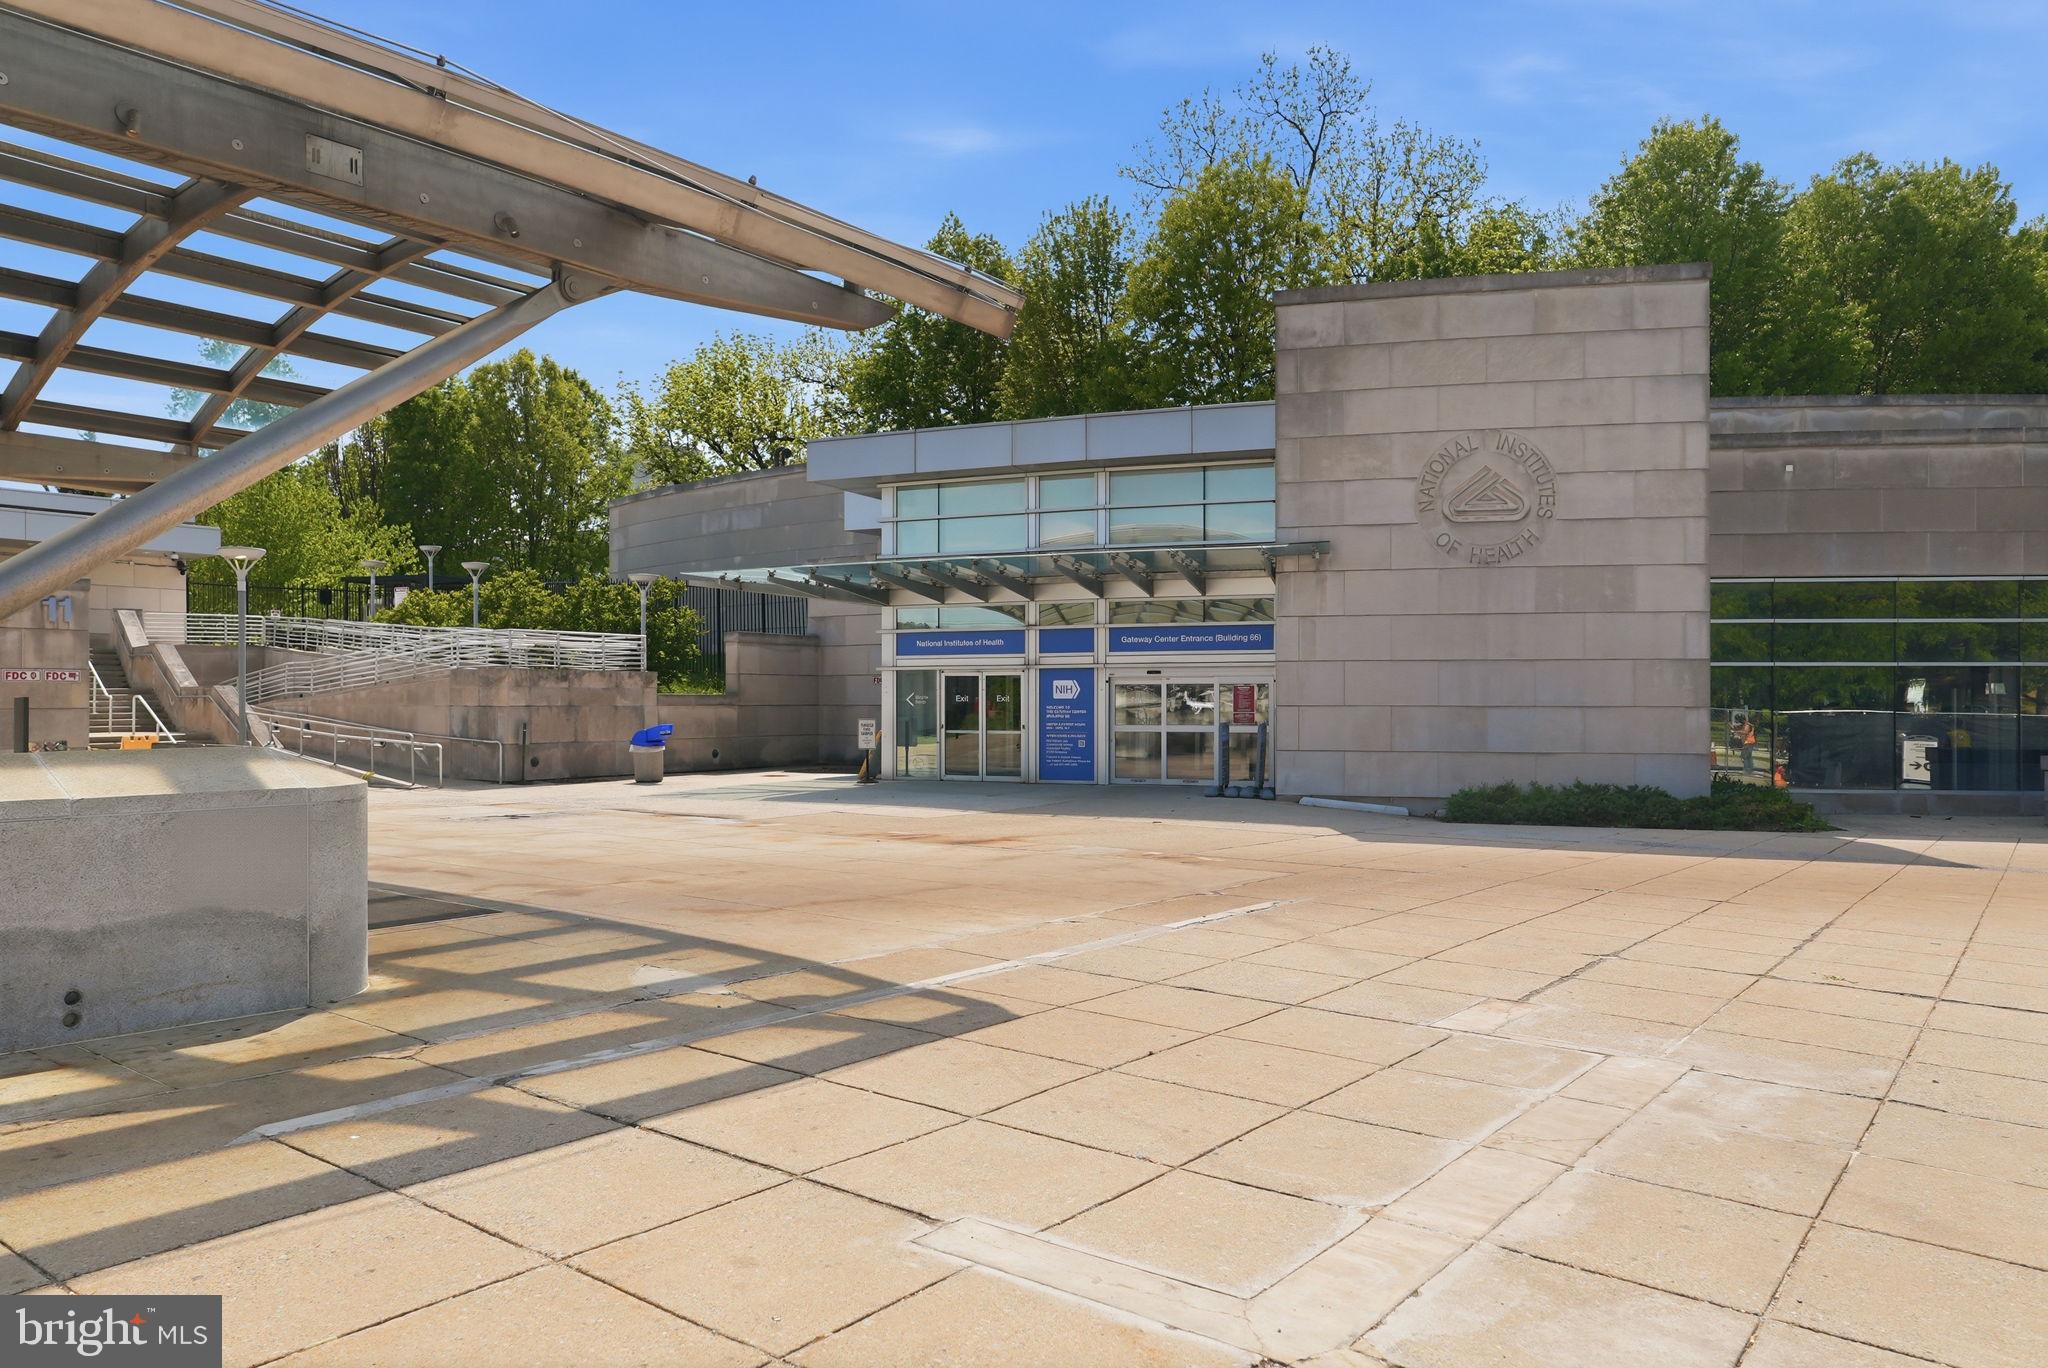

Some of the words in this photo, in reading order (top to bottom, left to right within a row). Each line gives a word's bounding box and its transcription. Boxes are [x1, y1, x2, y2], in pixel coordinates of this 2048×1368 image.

[1417, 435, 1480, 513] NATIONAL
[1496, 432, 1556, 519] INSTITUTES
[1435, 532, 1463, 555] OF
[1469, 528, 1540, 565] HEALTH
[41, 595, 72, 624] 11
[916, 639, 943, 648] National
[944, 639, 974, 647] Institutes
[974, 639, 982, 647] of
[982, 638, 1005, 647] Health
[1121, 635, 1153, 645] Gateway
[1154, 634, 1179, 643] Center
[1180, 634, 1214, 643] Entrance
[1215, 633, 1248, 643] (Building
[5, 671, 28, 680] FDC
[45, 671, 67, 681] FDC
[1055, 685, 1073, 695] NIH
[955, 694, 969, 703] Exit
[996, 694, 1010, 703] Exit
